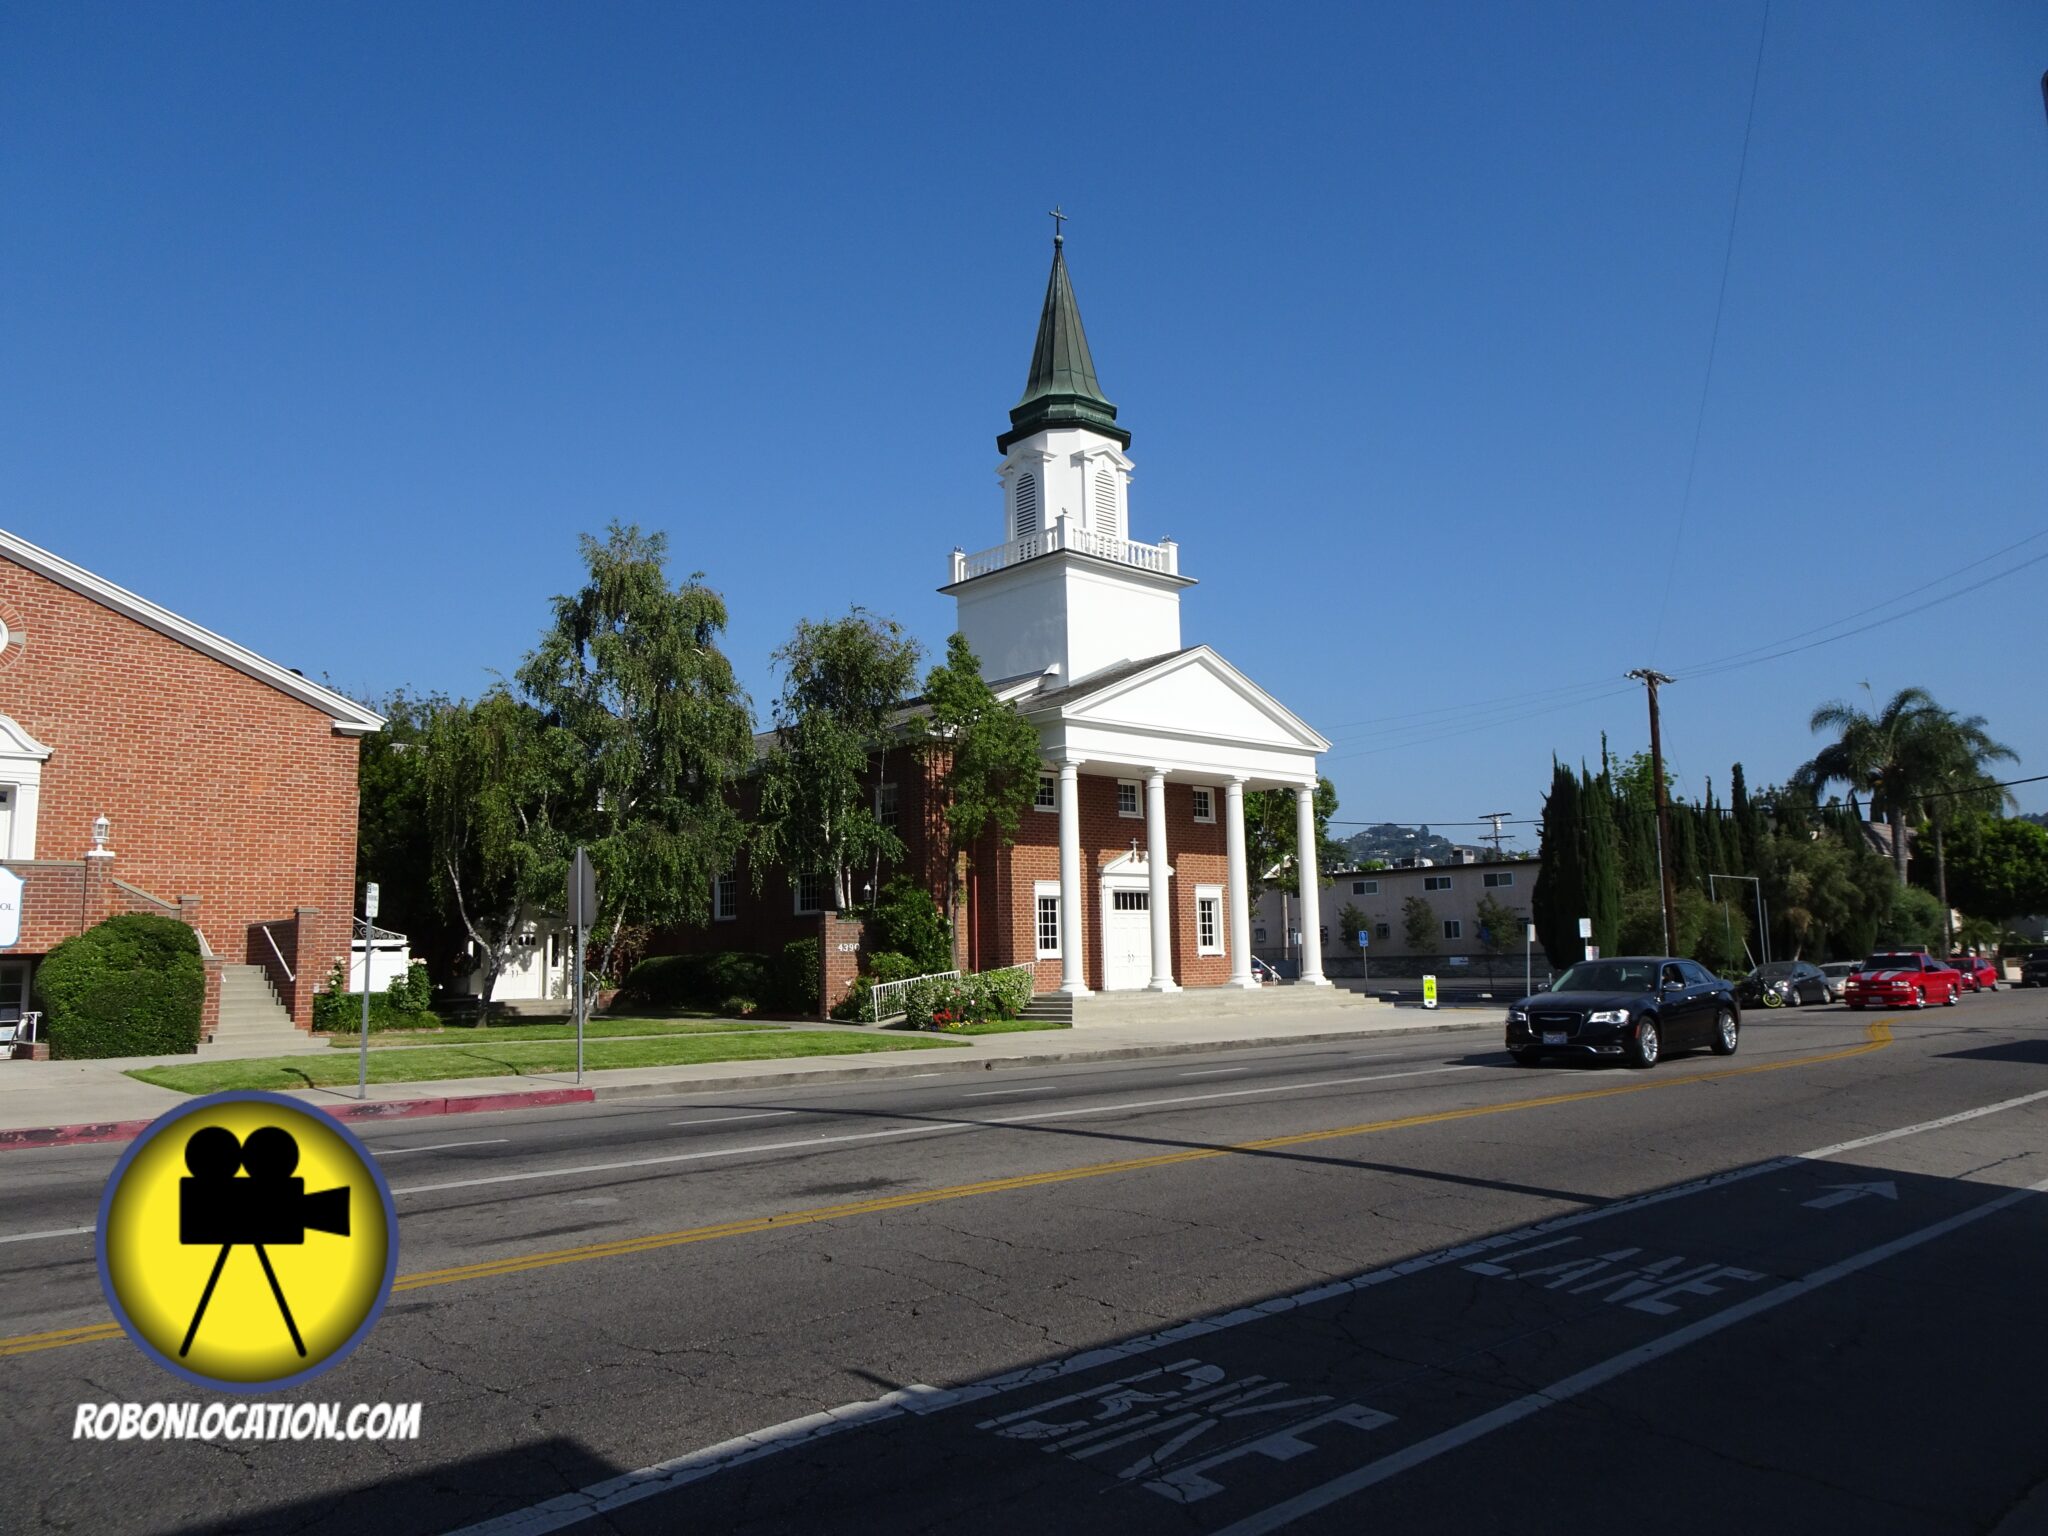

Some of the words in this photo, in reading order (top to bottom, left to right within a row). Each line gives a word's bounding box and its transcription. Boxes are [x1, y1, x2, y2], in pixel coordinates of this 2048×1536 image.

[0, 902, 14, 911] OL
[838, 943, 861, 952] 4390
[1460, 1236, 1769, 1316] LANE
[975, 1358, 1399, 1504] BIKE
